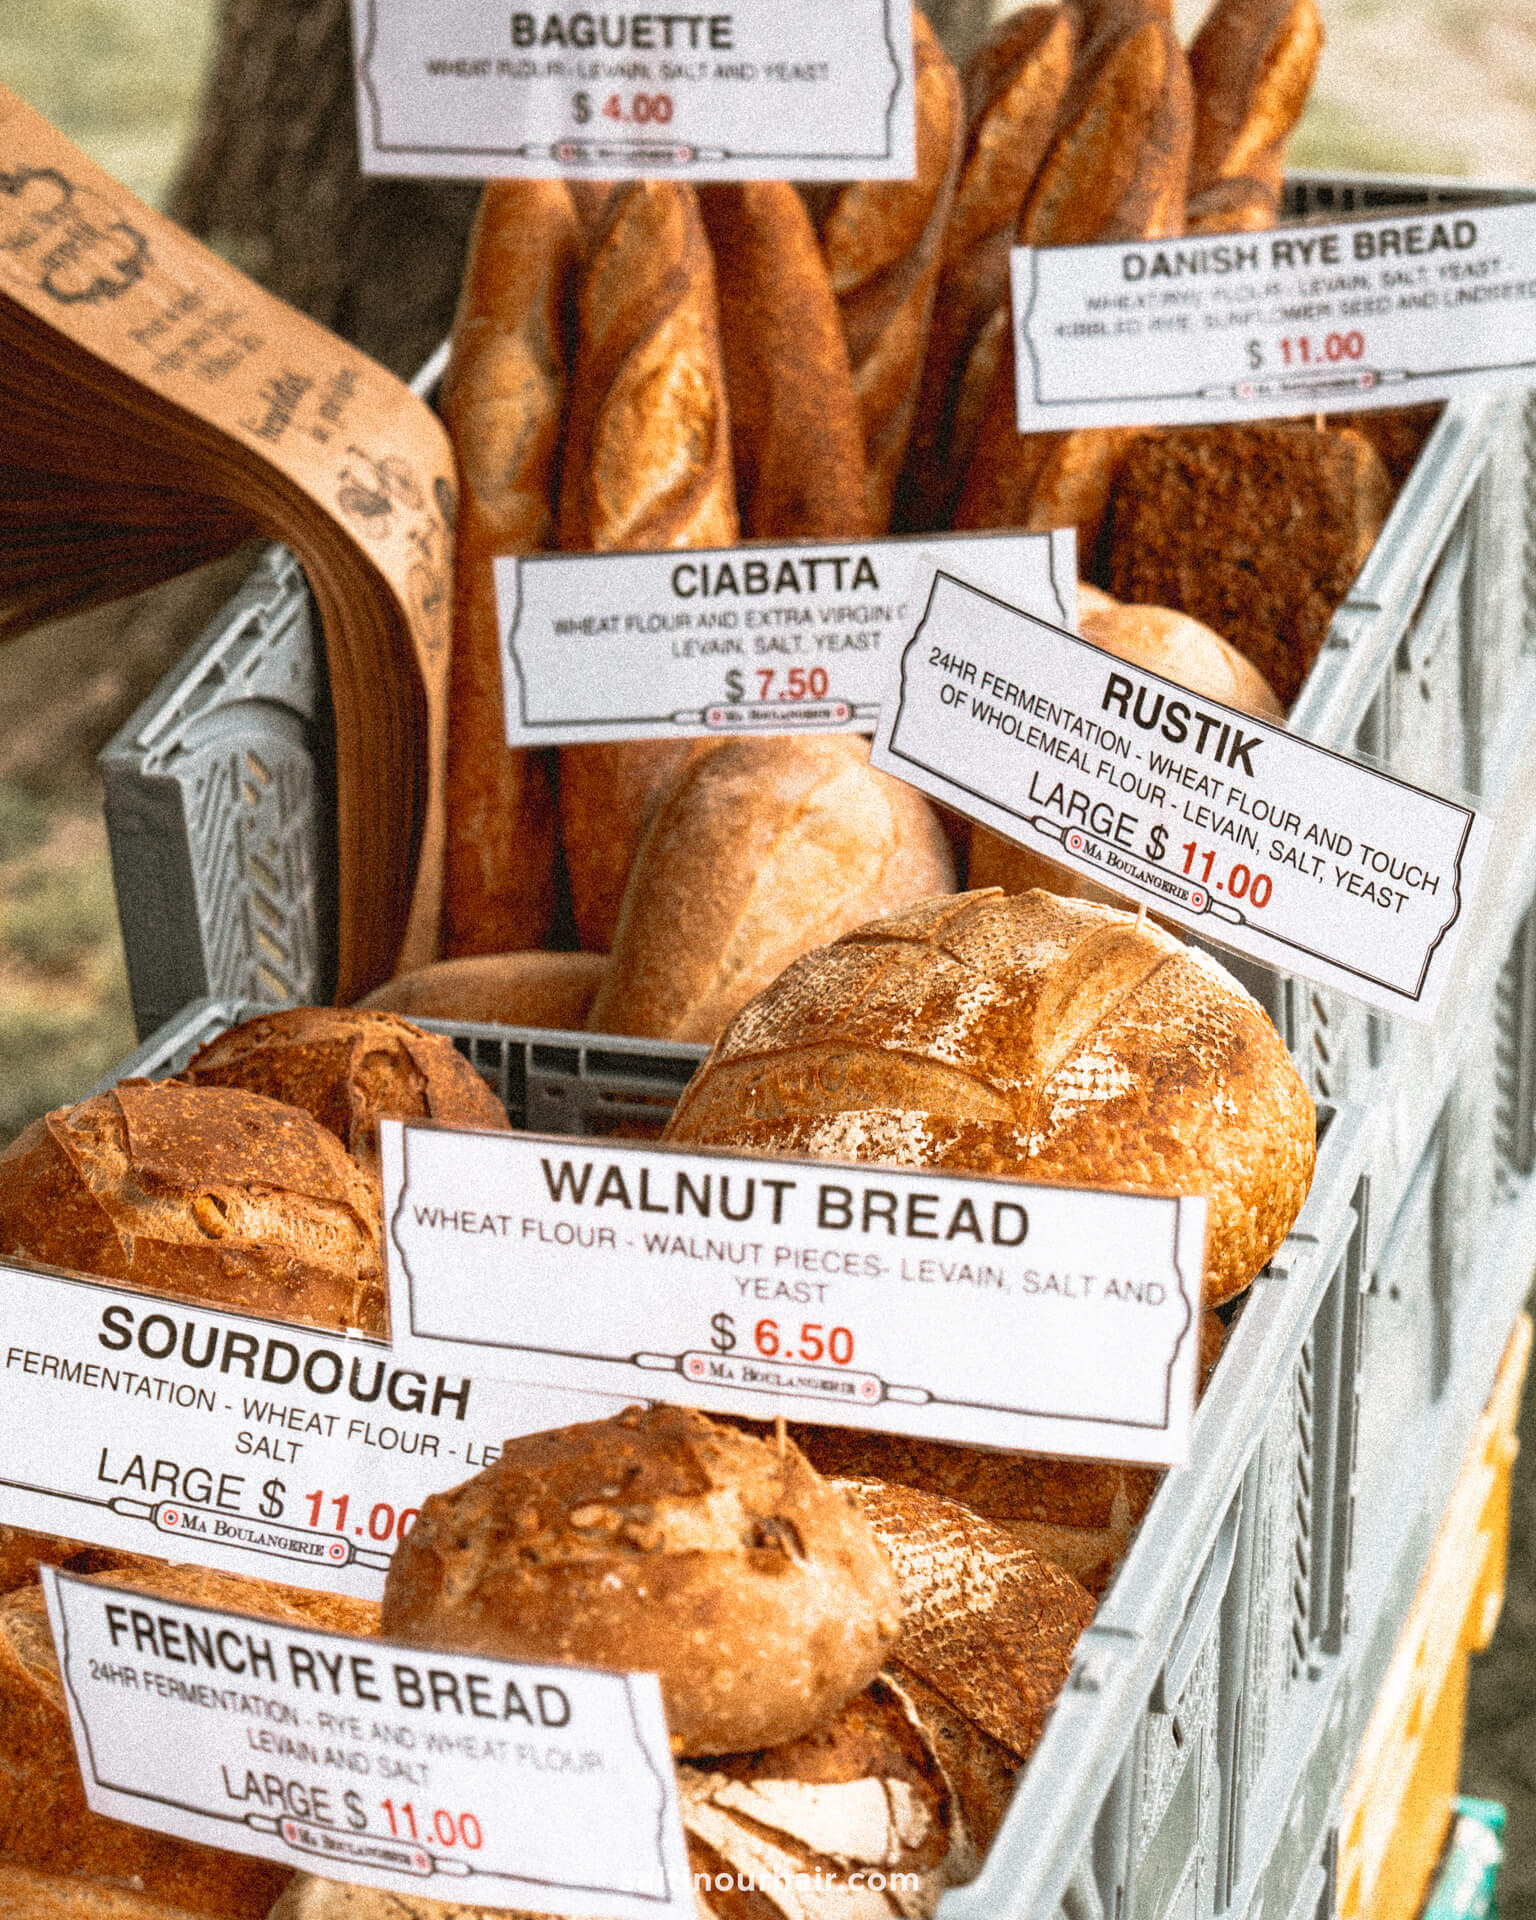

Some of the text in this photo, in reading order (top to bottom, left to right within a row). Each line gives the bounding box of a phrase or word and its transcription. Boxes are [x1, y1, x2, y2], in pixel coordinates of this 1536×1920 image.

[511, 11, 733, 49] BAGUETTE
[572, 91, 674, 124] $ 4.00
[1122, 219, 1477, 281] DANISH RYE BREAD
[1245, 330, 1365, 370] $ 11.00
[671, 556, 879, 598] CIABATTA
[553, 614, 619, 636] WHEAT
[624, 611, 692, 633] FLOUR
[698, 610, 738, 630] AND
[744, 606, 812, 628] EXTRA
[817, 604, 891, 625] VIRGIN
[813, 630, 881, 651] YEAST
[725, 665, 830, 702] $ 7.50
[1101, 671, 1264, 778] RUSTIK
[928, 646, 977, 685] 24HR
[980, 671, 1131, 759] FERMENTATION
[1150, 751, 1224, 799] WHEAT
[1226, 787, 1302, 836] FLOUR
[1303, 823, 1353, 856] AND
[1360, 843, 1440, 896] TOUCH
[940, 684, 968, 709] OF
[971, 697, 1091, 774] WHOLEMEAL
[1096, 759, 1166, 809] FLOUR
[1183, 800, 1261, 856] LEVAIN,
[1269, 839, 1326, 884] SALT,
[1334, 865, 1410, 914] YEAST
[1028, 770, 1273, 909] LARGE $ 11.00
[540, 1158, 1030, 1247] WALNUT BREAD
[413, 1205, 513, 1237] WHEAT
[522, 1217, 617, 1249] FLOUR
[643, 1232, 764, 1265] WALNUT
[1023, 1268, 1098, 1299] SALT
[1103, 1278, 1168, 1307] AND
[735, 1275, 830, 1304] YEAST
[98, 1305, 472, 1421] SOURDOUGH
[710, 1311, 855, 1366] $ 6.50
[6, 1346, 216, 1412] FERMENTATION
[243, 1397, 341, 1437] WHEAT
[347, 1419, 440, 1458] FLOUR
[235, 1430, 303, 1464] SALT
[97, 1446, 245, 1510] LARGE
[258, 1477, 287, 1519] $
[105, 1603, 572, 1728] FRENCH RYE BREAD
[88, 1658, 139, 1689] 24HR
[143, 1671, 299, 1727] FERMENTATION
[317, 1711, 363, 1740] RYE
[371, 1721, 416, 1749] AND
[425, 1731, 507, 1761] WHEAT
[246, 1727, 429, 1785] LEVAIN AND SALT
[221, 1763, 334, 1824] LARGE
[343, 1788, 368, 1830] $
[380, 1797, 483, 1851] 11.00
